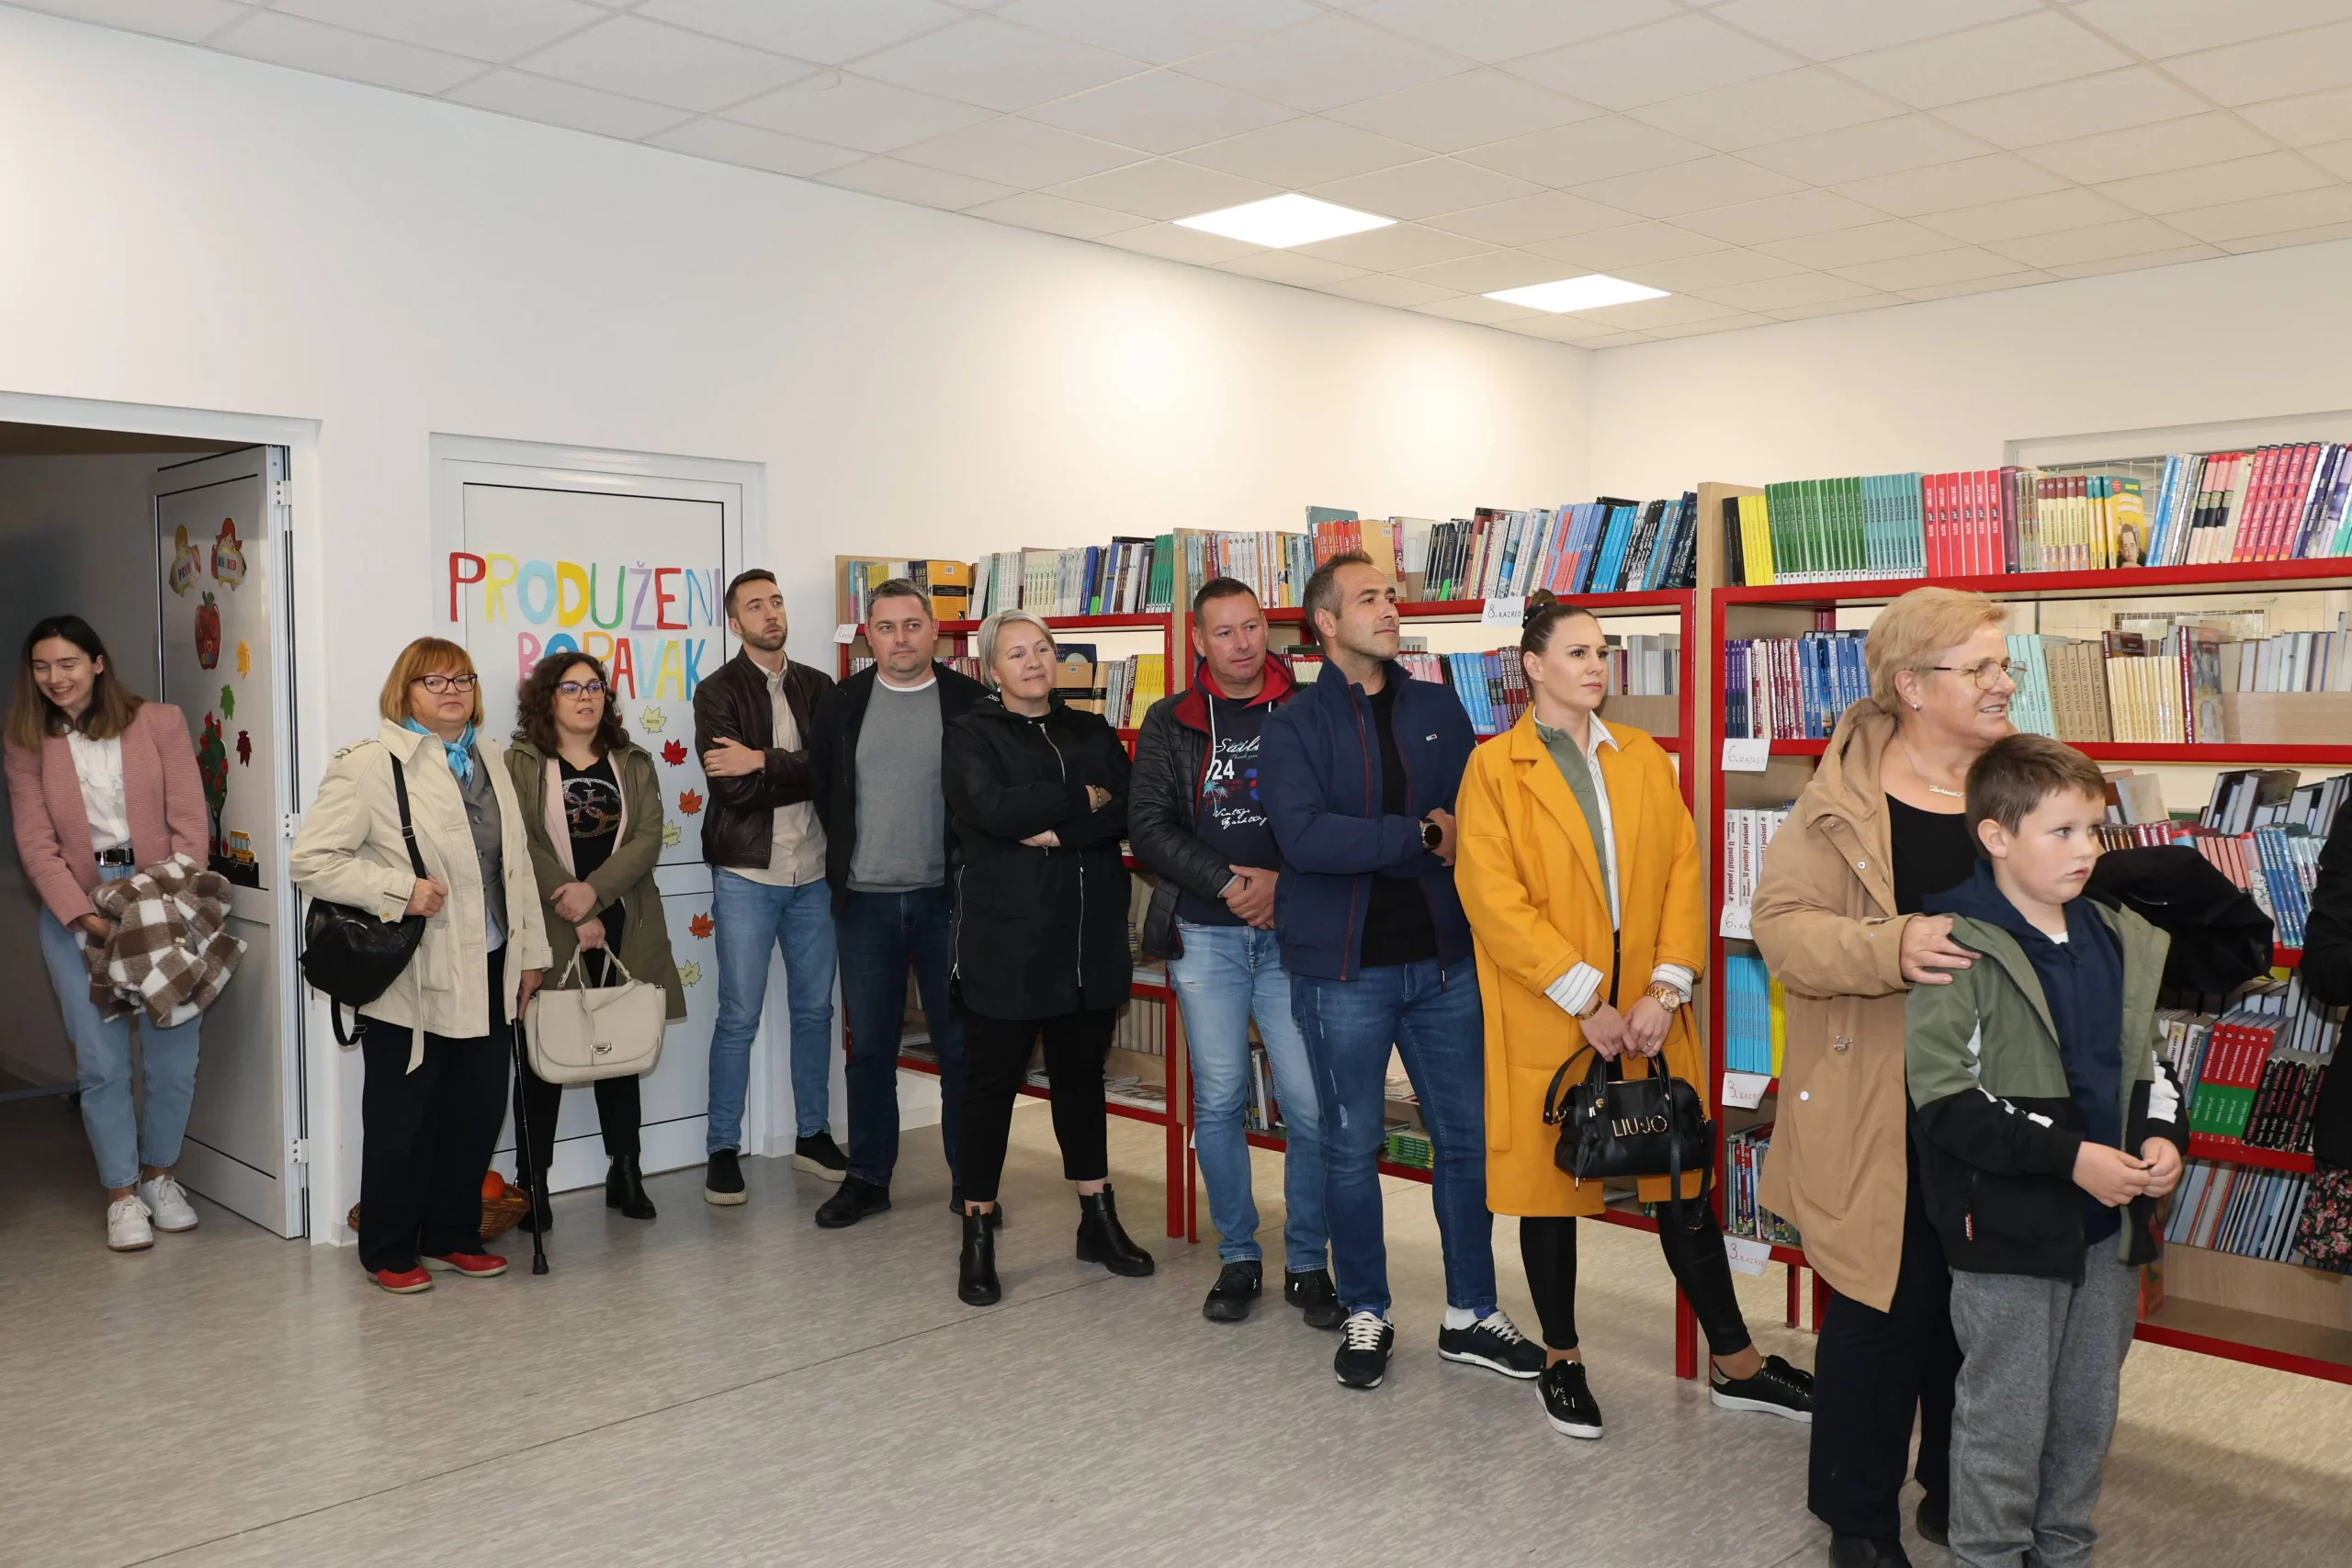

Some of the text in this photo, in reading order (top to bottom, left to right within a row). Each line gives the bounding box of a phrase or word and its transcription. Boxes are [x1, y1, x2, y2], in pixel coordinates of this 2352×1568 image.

[2300, 471, 2308, 483] DOM
[448, 551, 723, 631] PRODUŽENI
[1488, 604, 1498, 619] 8.
[1727, 746, 1738, 762] 6.
[1213, 759, 1235, 780] 24
[1742, 823, 1750, 845] prašumi
[1760, 823, 1769, 845] prašumi
[1725, 913, 1736, 928] 6.
[1727, 1080, 1738, 1099] 3.
[1729, 1242, 1738, 1260] 3.
